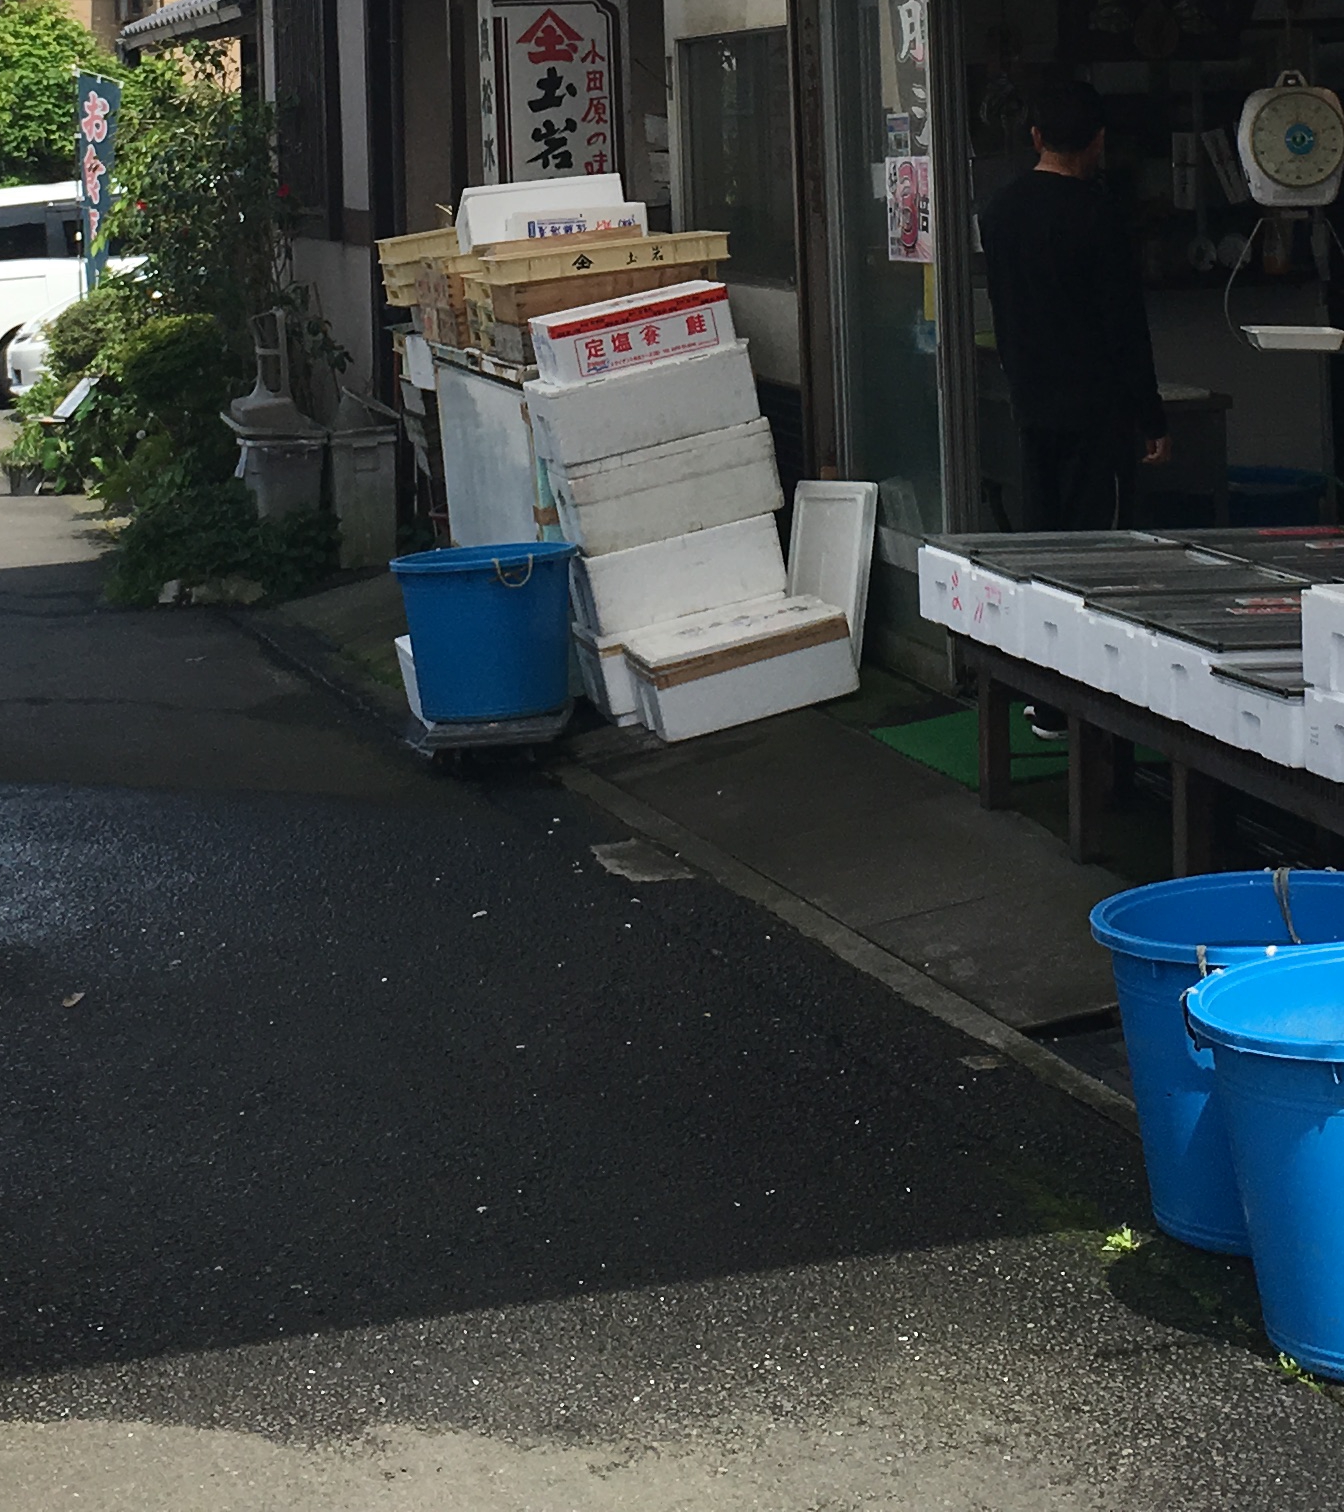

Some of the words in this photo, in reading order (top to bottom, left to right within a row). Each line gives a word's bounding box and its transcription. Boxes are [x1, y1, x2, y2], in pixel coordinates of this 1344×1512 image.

[581, 38, 609, 175] 小田原の味
